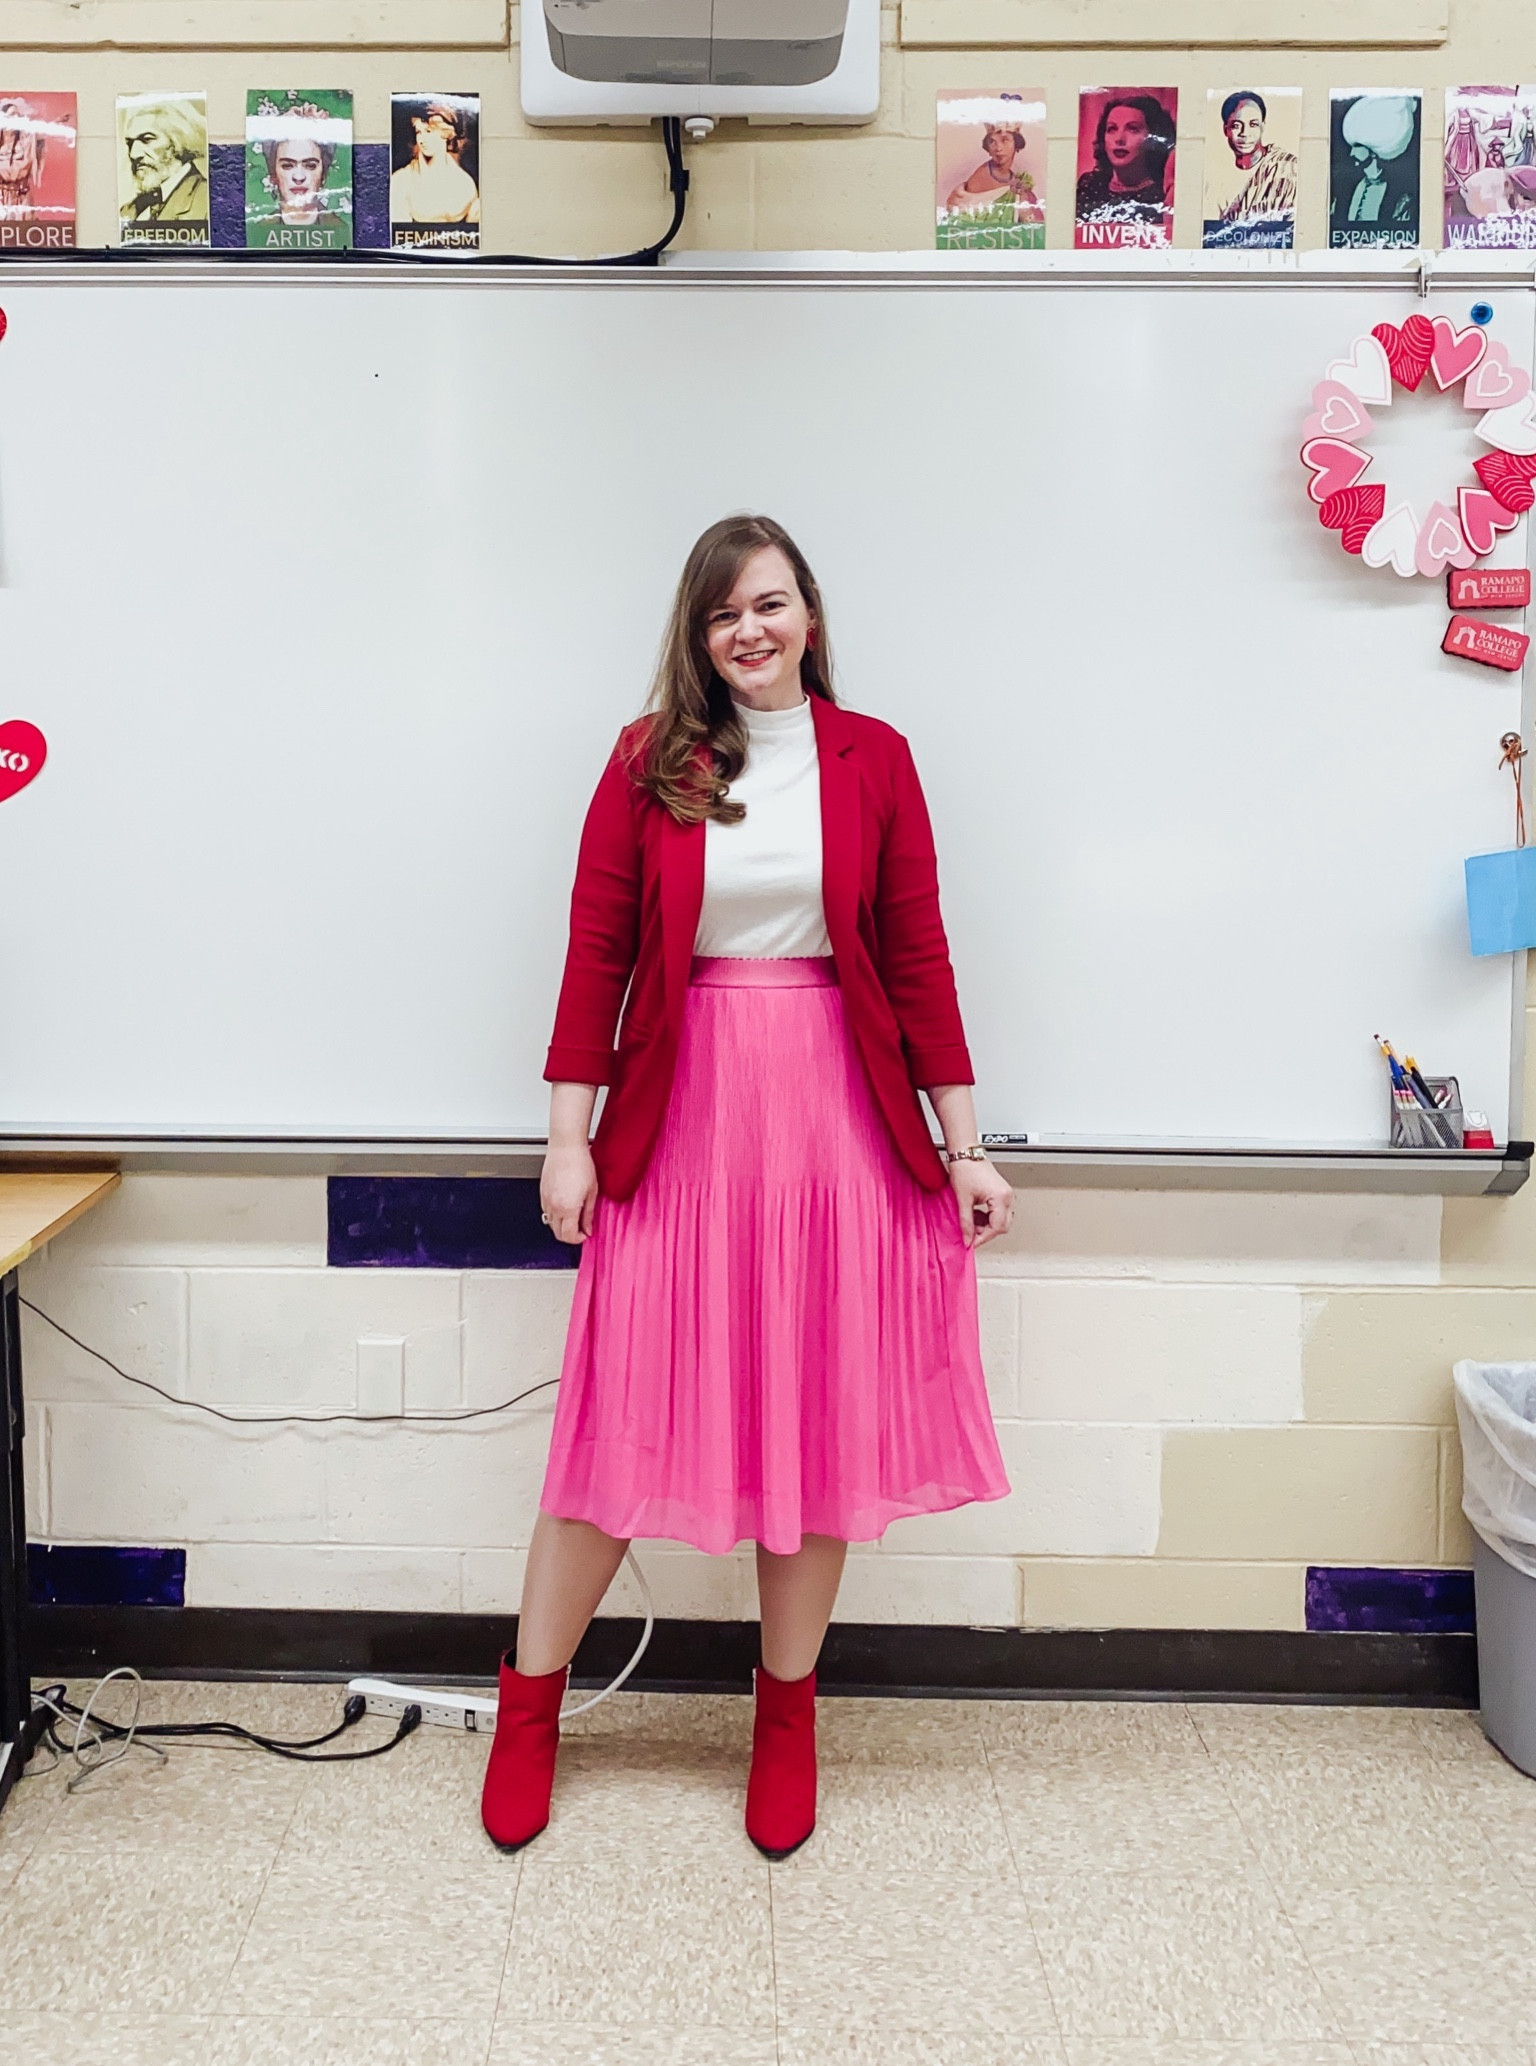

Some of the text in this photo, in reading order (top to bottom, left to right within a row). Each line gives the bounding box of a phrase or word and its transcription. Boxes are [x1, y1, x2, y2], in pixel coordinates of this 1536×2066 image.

[124, 228, 206, 243] FREEDOM
[265, 229, 335, 247] ARTIST
[395, 230, 477, 246] FEMINISM
[947, 225, 1041, 249] RESIST
[1082, 225, 1167, 245] INVENT
[1332, 230, 1416, 244] EXPANSION
[1481, 576, 1524, 585] RAMAPO
[1481, 585, 1524, 594] COLLEGE
[1479, 629, 1522, 649] RAMAPO
[1476, 639, 1518, 657] COLLEGE
